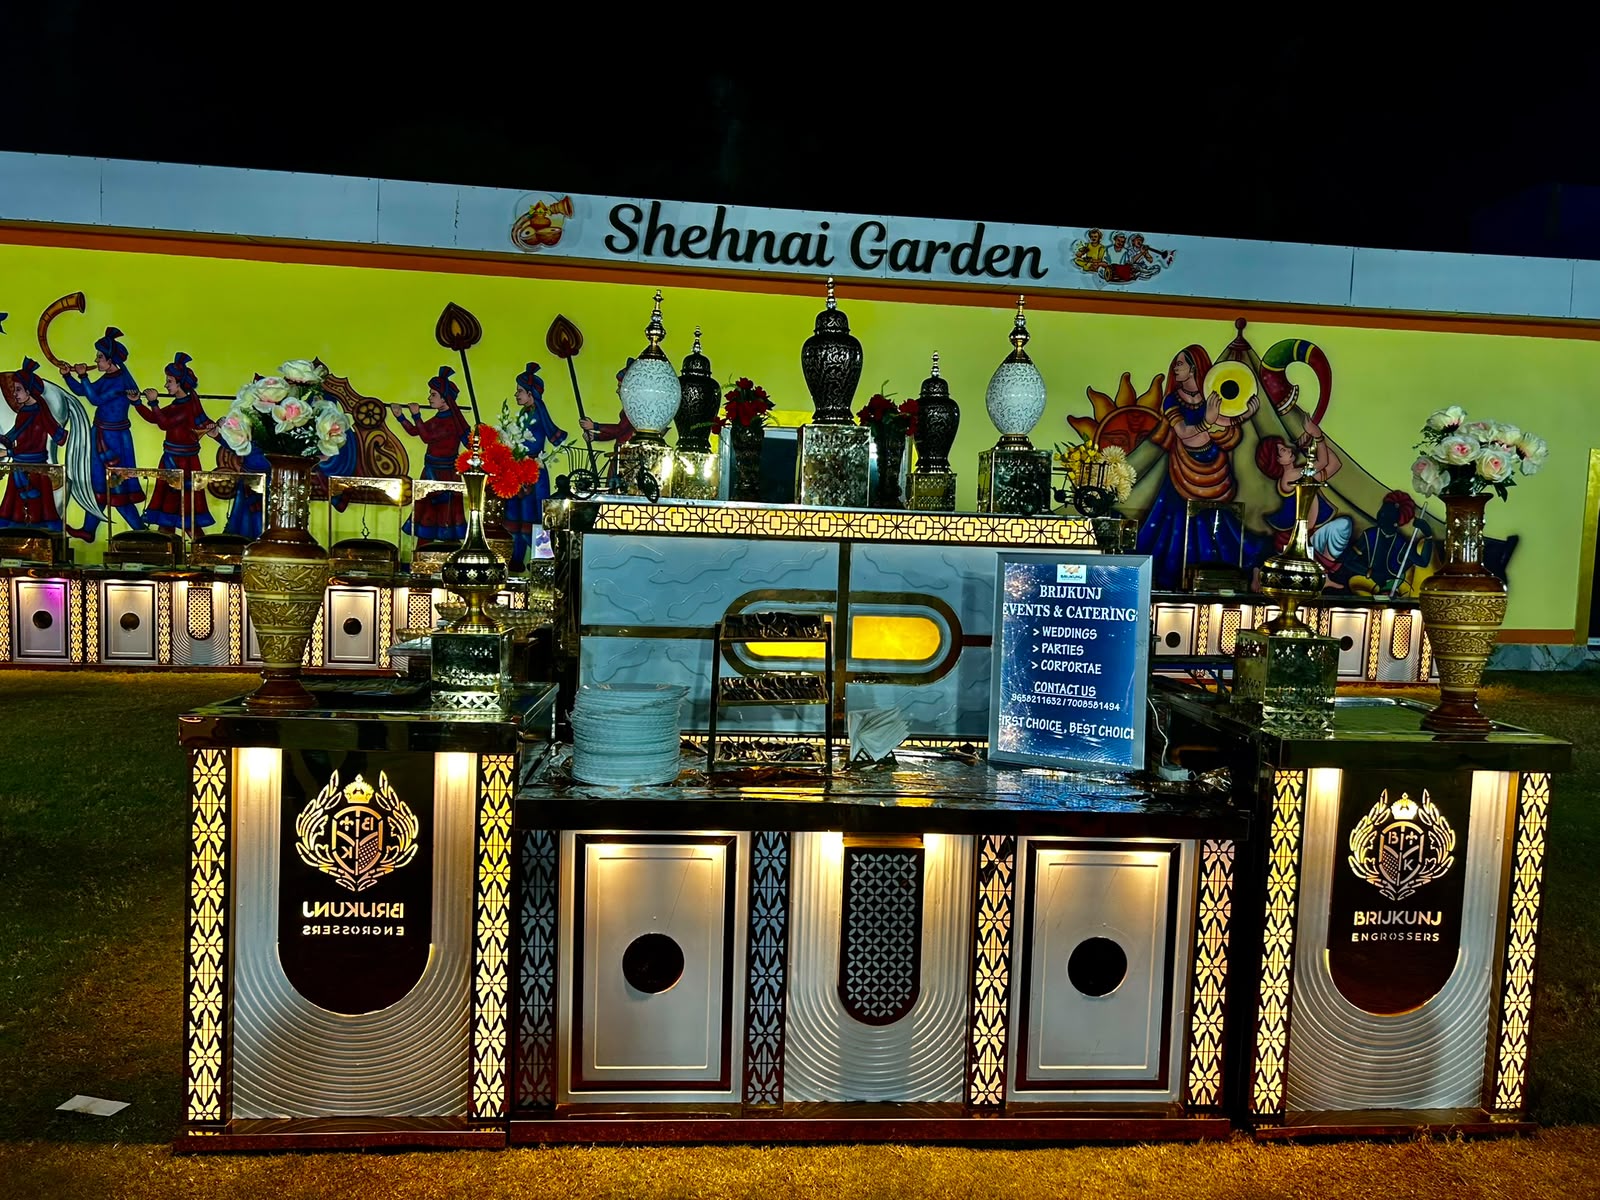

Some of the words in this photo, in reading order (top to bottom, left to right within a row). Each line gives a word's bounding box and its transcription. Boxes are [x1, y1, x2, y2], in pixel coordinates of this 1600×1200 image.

[604, 200, 835, 267] Shehnai
[850, 220, 1048, 279] Garden
[1039, 584, 1102, 600] BRIJKUNJ
[1002, 602, 1050, 617] EVENTS
[1053, 605, 1063, 618] &
[1066, 605, 1138, 622] CATERING
[1042, 626, 1097, 640] WEDDINGS
[1041, 643, 1084, 656] PARTIES
[1040, 659, 1102, 675] CORPORTAE
[1034, 681, 1079, 696] CONTACT
[1081, 685, 1096, 697] US
[1069, 722, 1097, 736] BEST
[1353, 910, 1442, 926] BRIJKUNJ
[1351, 932, 1440, 942] ENGROSSERS
